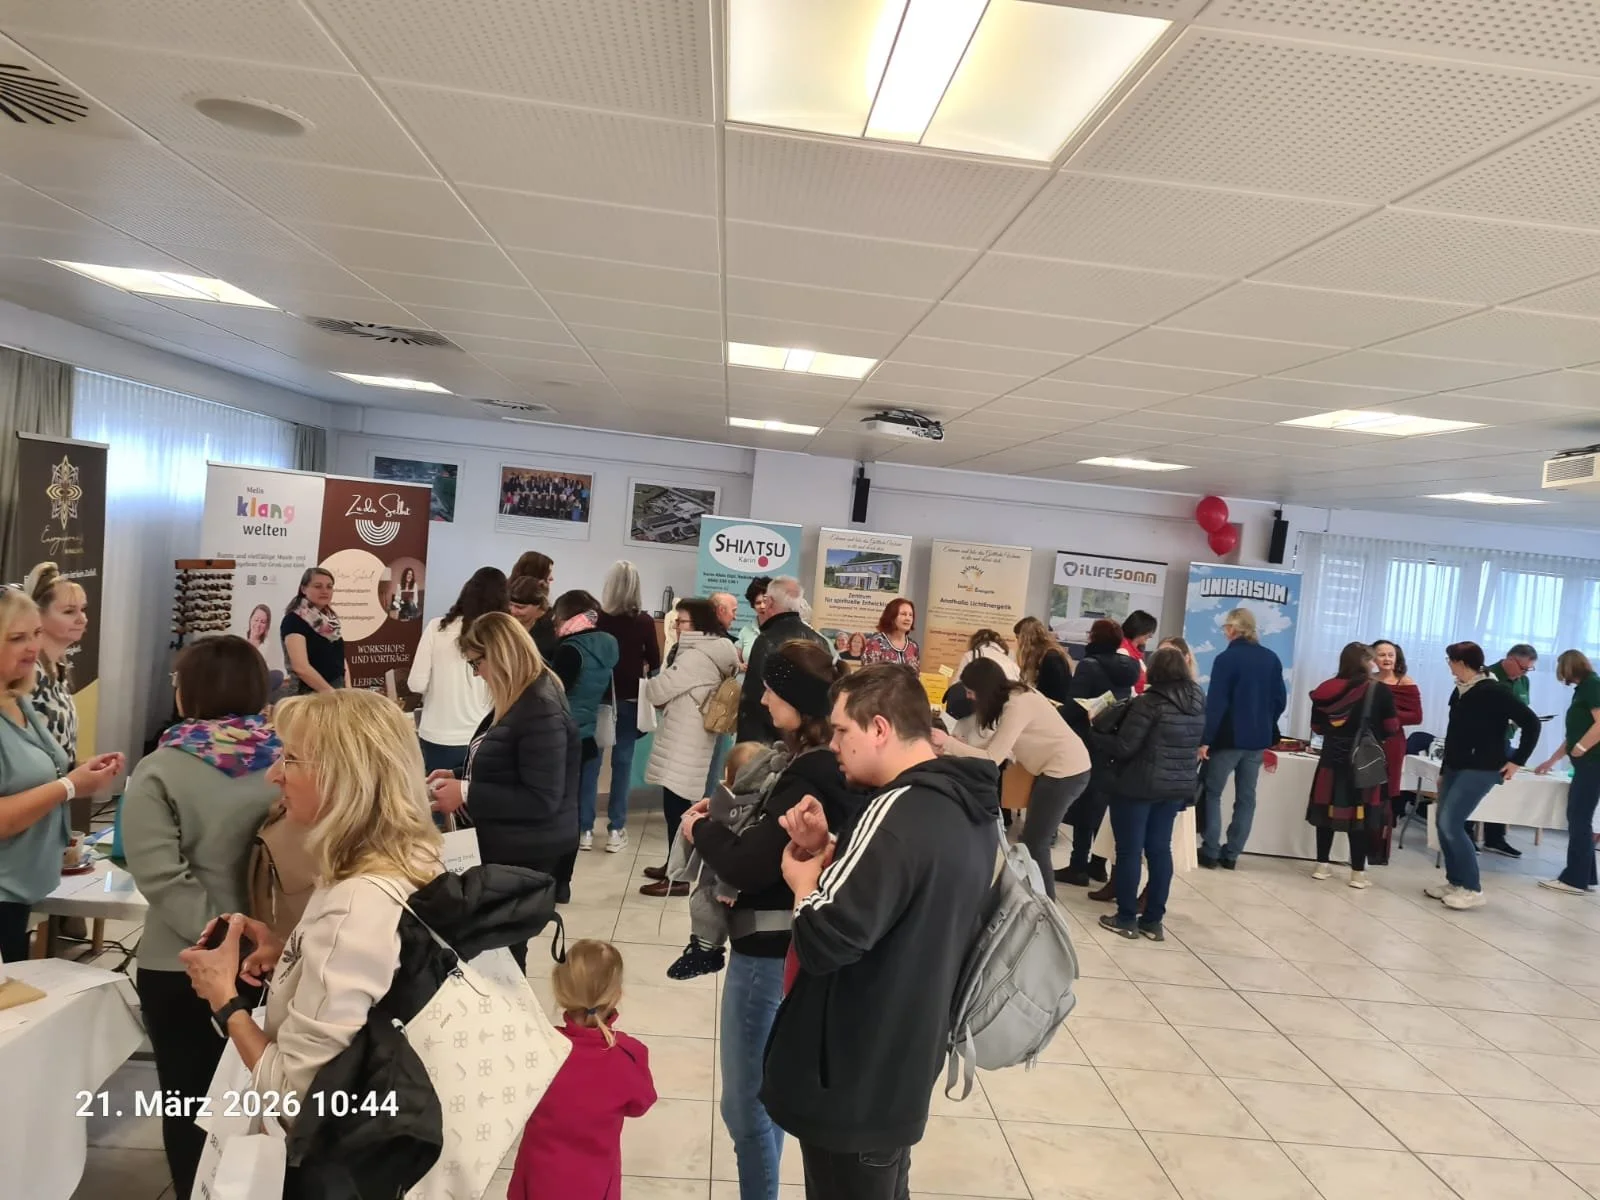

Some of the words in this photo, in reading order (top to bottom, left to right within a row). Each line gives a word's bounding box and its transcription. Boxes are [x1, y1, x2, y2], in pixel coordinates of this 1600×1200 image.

[236, 495, 295, 525] klang
[242, 523, 287, 537] welten
[715, 534, 786, 558] SHIATSU
[738, 557, 757, 566] Karin
[1200, 577, 1288, 605] UNIBRISUM
[357, 643, 406, 654] WORKSHOPS
[351, 655, 369, 665] UND
[370, 652, 410, 664] VORTRÄGE
